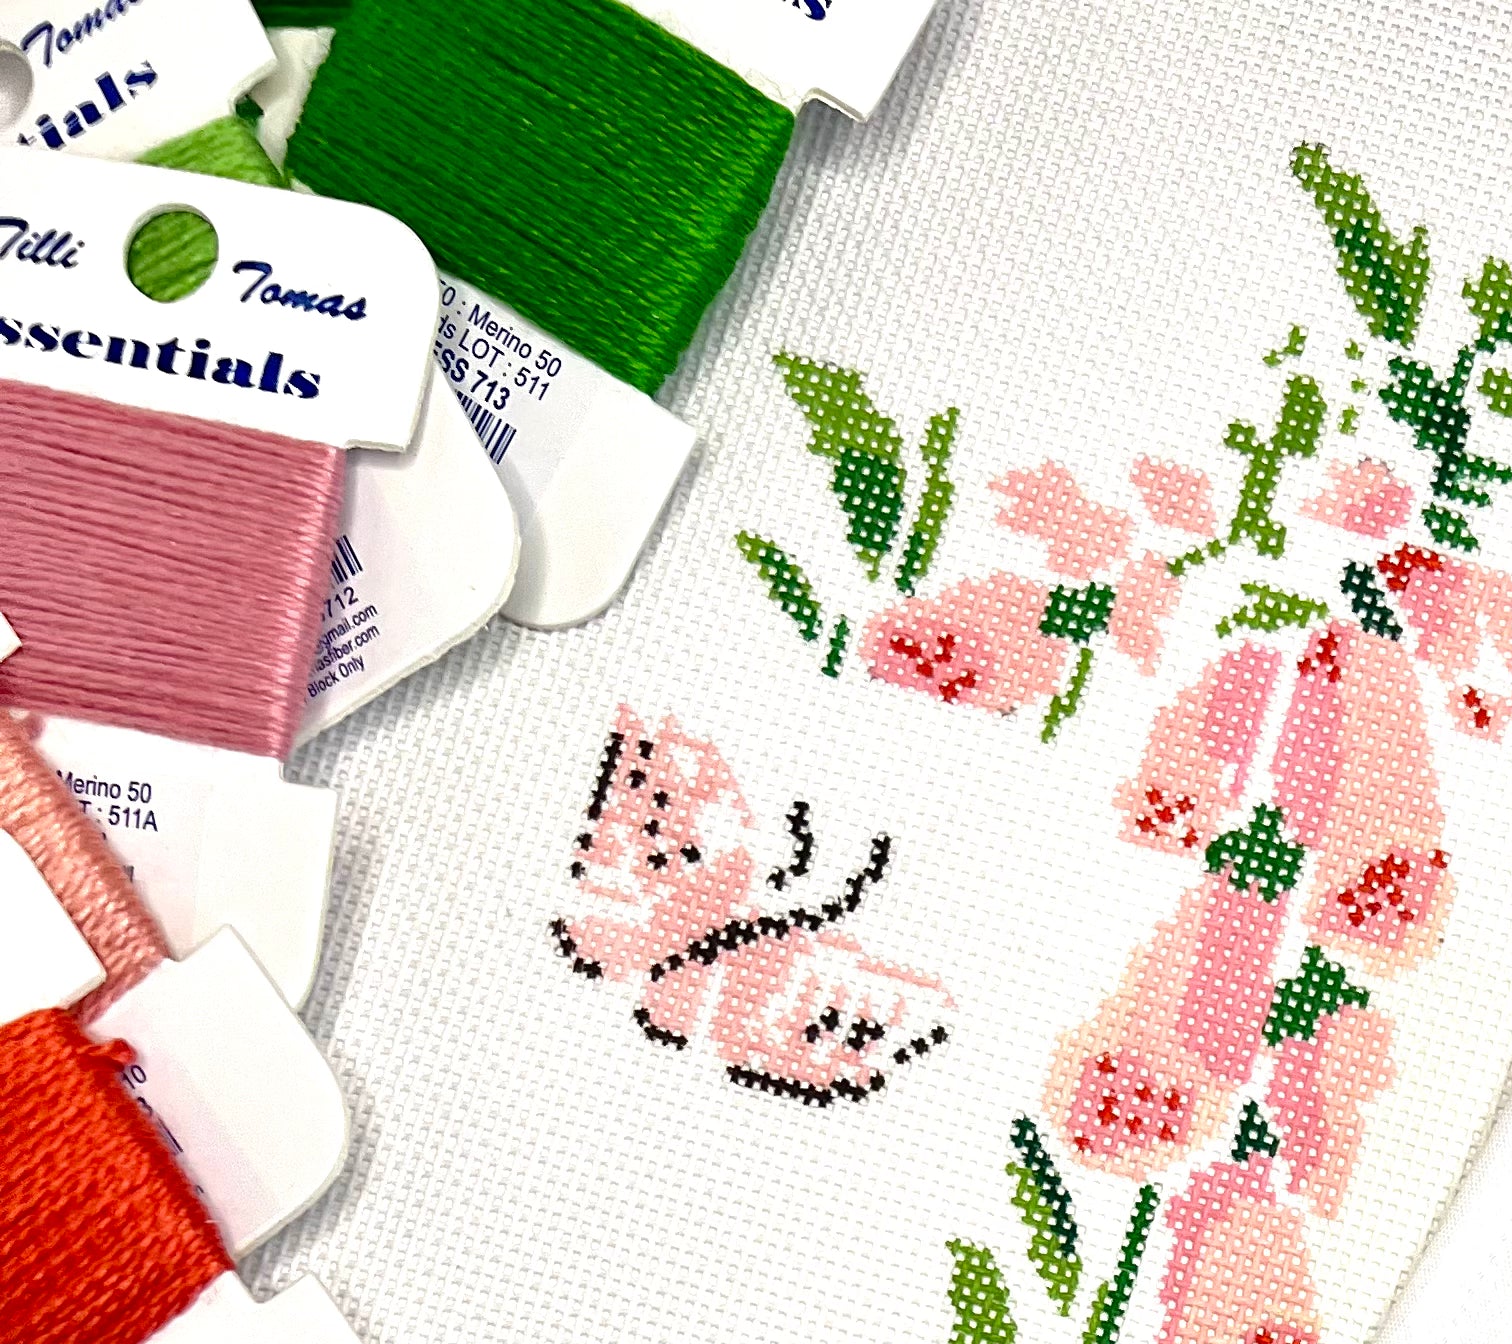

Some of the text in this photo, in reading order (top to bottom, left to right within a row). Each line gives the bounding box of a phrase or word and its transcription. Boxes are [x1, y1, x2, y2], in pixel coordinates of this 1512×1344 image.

[21, 0, 144, 68] Toma
[0, 216, 366, 320] Tilli Tomas
[458, 329, 505, 368] LOT
[514, 367, 550, 401] 511
[468, 304, 532, 359] Merino
[535, 350, 562, 378] 50
[470, 370, 510, 410] 713
[338, 655, 366, 678] Only
[108, 806, 158, 832] 511A
[128, 782, 153, 804] 50
